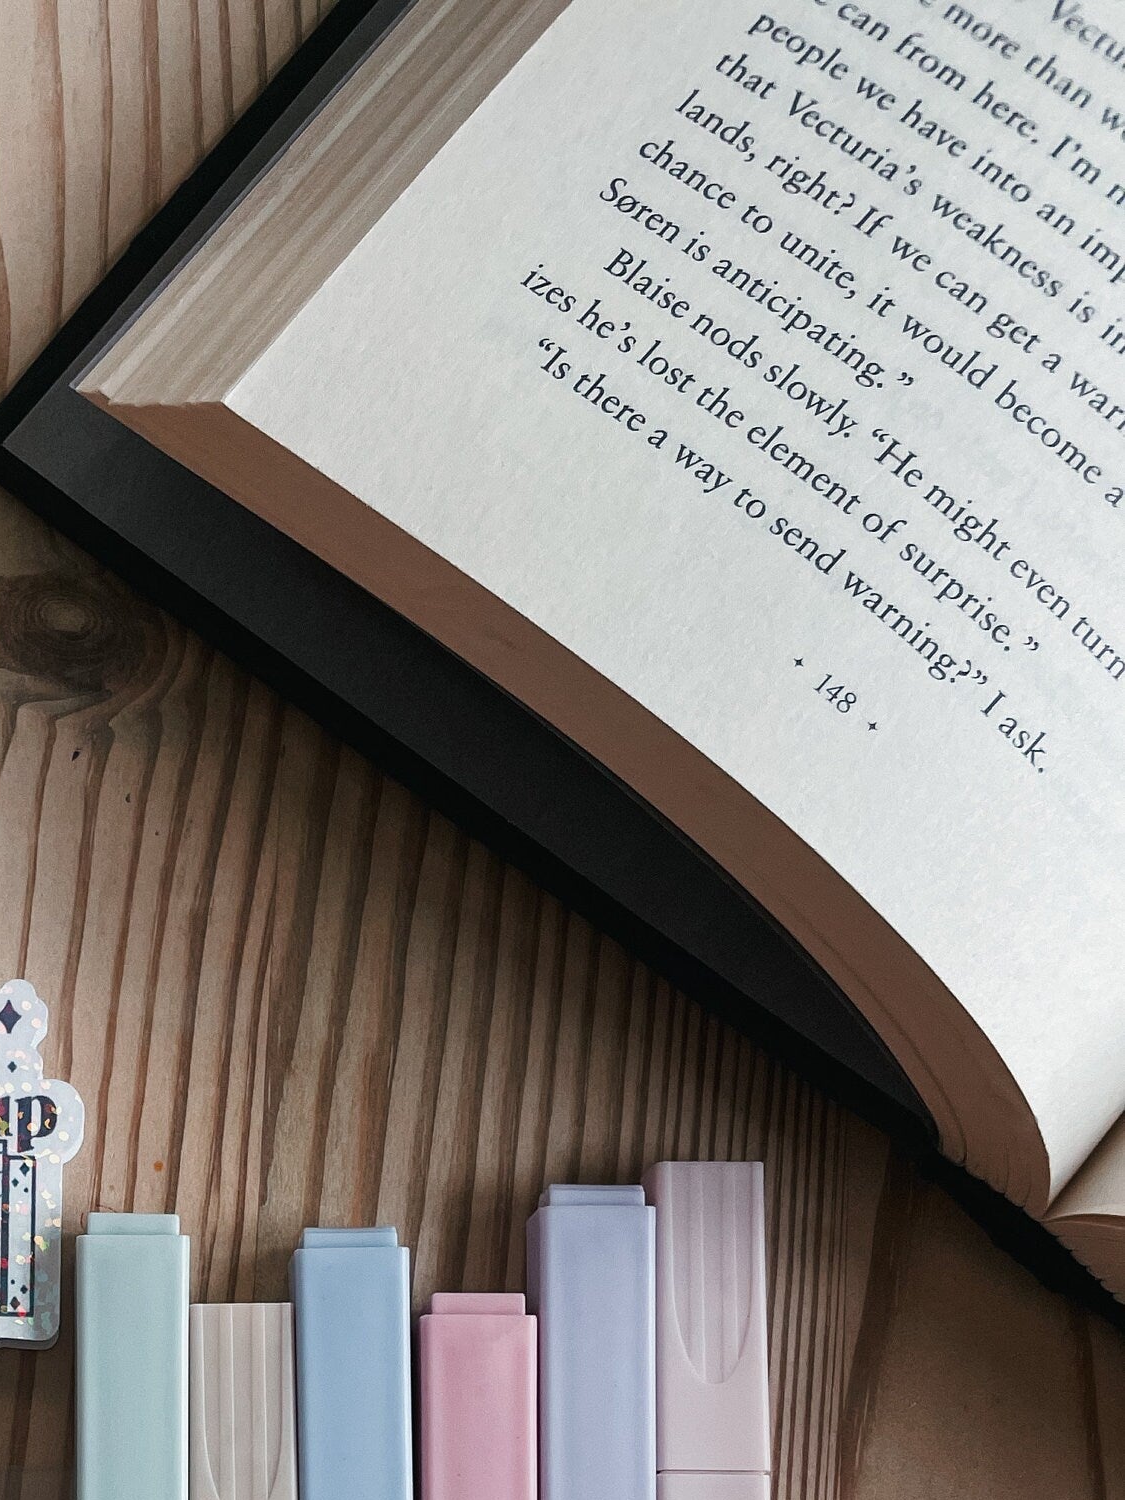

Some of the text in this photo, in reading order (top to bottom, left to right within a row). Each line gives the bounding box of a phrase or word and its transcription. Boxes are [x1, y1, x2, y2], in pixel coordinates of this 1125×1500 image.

[748, 14, 850, 80] people
[856, 76, 896, 110] we
[900, 100, 968, 157] have
[969, 150, 1032, 202] into
[1036, 203, 1075, 237] an
[837, 3, 891, 42] can
[893, 33, 967, 91] from
[972, 80, 1039, 144] here.
[1050, 135, 1102, 185] I’m
[943, 4, 1125, 141] more than w
[1051, 0, 1125, 70] Vectu
[599, 178, 681, 243] Søren
[682, 231, 711, 262] is
[675, 89, 756, 162] lands,
[764, 155, 856, 216] right?
[852, 205, 894, 238] If
[891, 235, 932, 272] we
[935, 271, 988, 315] can
[986, 312, 1041, 354] get
[1041, 353, 1062, 373] a
[715, 54, 776, 100] that
[788, 90, 922, 196] Vecturia’s
[931, 194, 1063, 297] weakness
[1067, 291, 1096, 323] is
[520, 264, 577, 312] izes
[577, 299, 637, 353] he’s
[637, 340, 696, 393] lost
[696, 387, 745, 428] the
[747, 426, 861, 515] element
[862, 512, 907, 543] of
[603, 248, 690, 318] Blaise
[689, 313, 762, 368] nods
[763, 364, 858, 438] slowly.
[872, 428, 923, 488] “He
[923, 485, 1011, 560] might
[1010, 559, 1070, 620] even
[639, 140, 737, 209] chance
[740, 204, 773, 233] to
[779, 231, 856, 299] unite,
[867, 287, 896, 317] it
[902, 314, 998, 389] would
[994, 379, 1102, 484] become
[538, 338, 1046, 774] “Is there a way to send warning?” I ask.
[812, 673, 857, 714] 148
